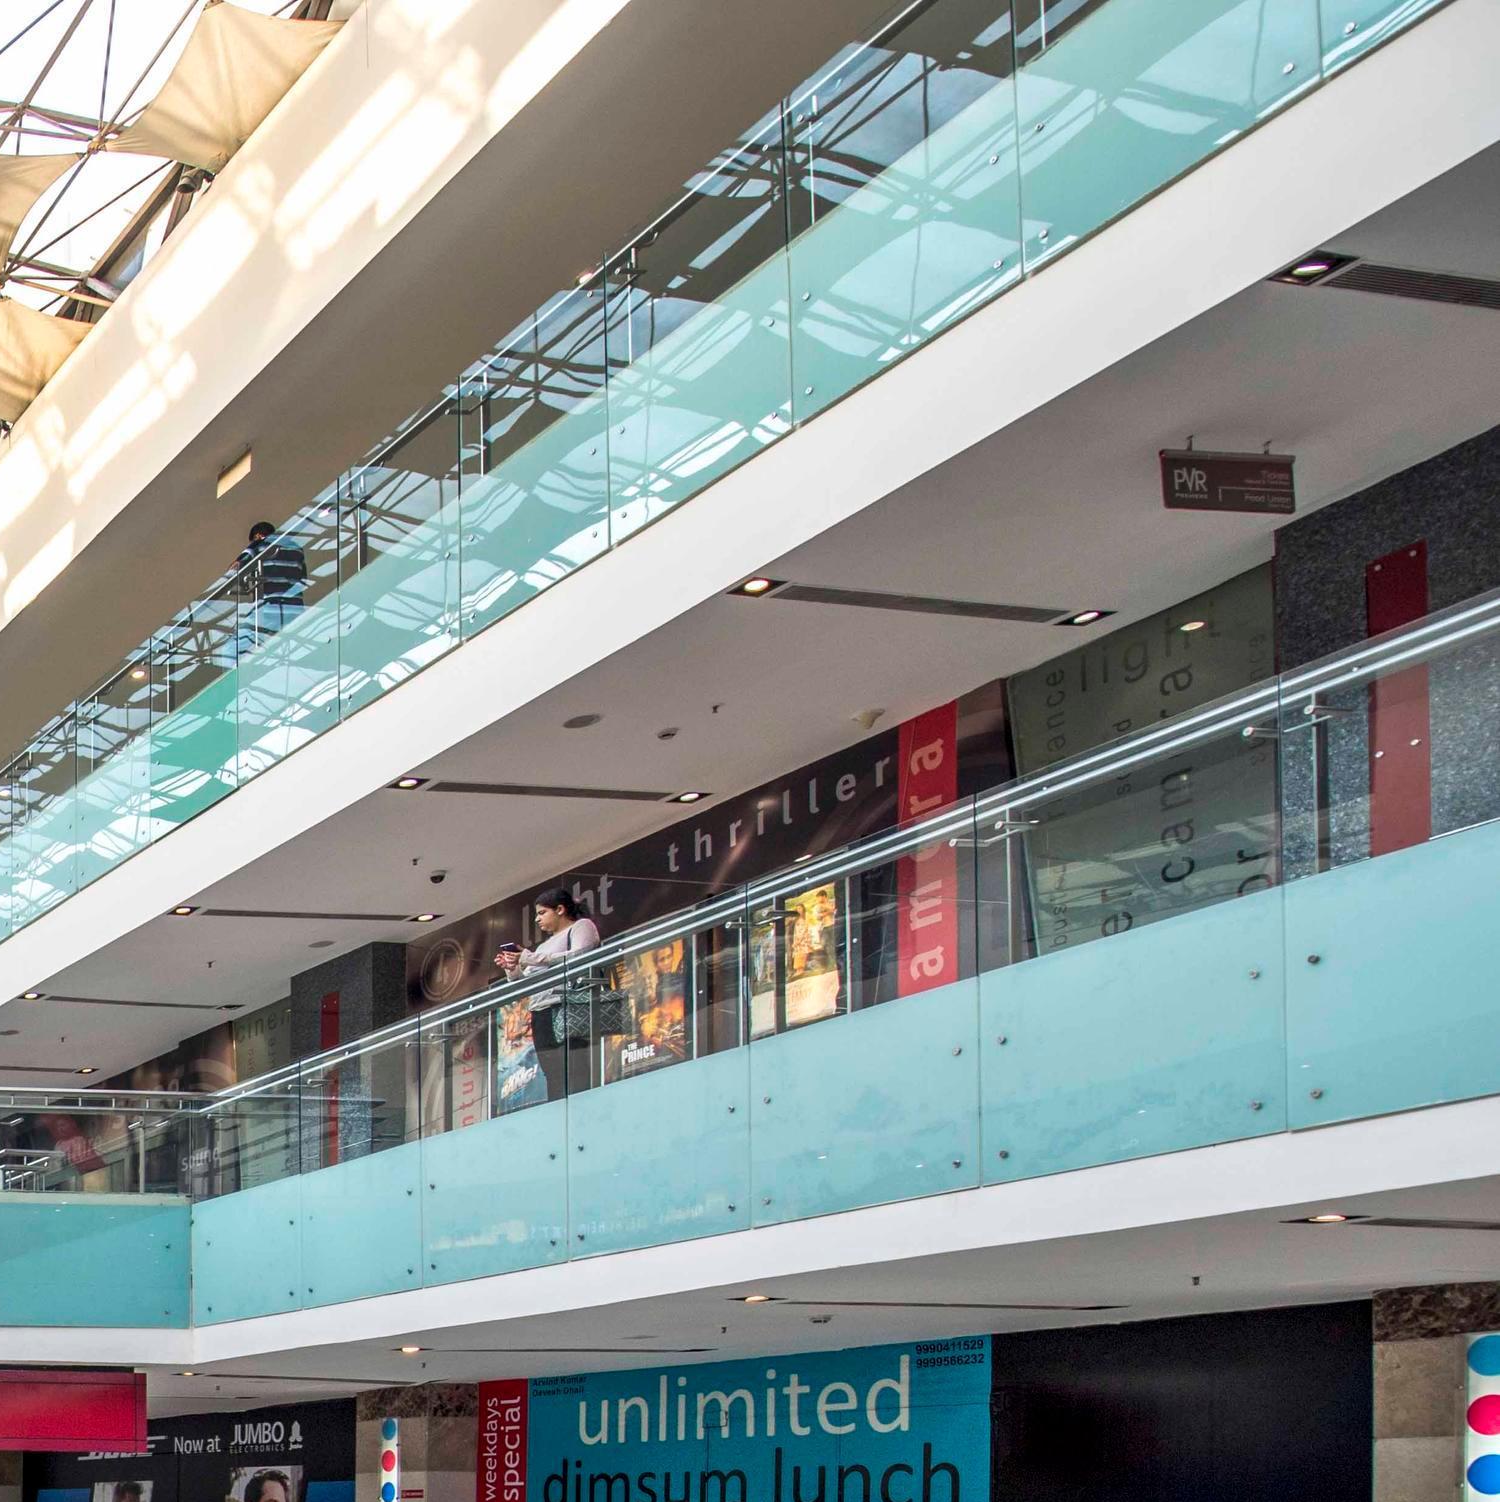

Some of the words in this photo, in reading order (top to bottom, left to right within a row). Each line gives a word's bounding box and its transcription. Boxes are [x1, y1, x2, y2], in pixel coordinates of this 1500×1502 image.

[1173, 466, 1208, 492] PVR
[666, 755, 894, 874] thriller
[621, 1044, 656, 1066] PRINCE
[578, 1355, 911, 1446] unlimited
[174, 1436, 204, 1455] Now
[206, 1438, 221, 1453] at
[230, 1421, 285, 1445] JUMBO
[484, 1396, 500, 1502] weekdays
[500, 1395, 525, 1502] special
